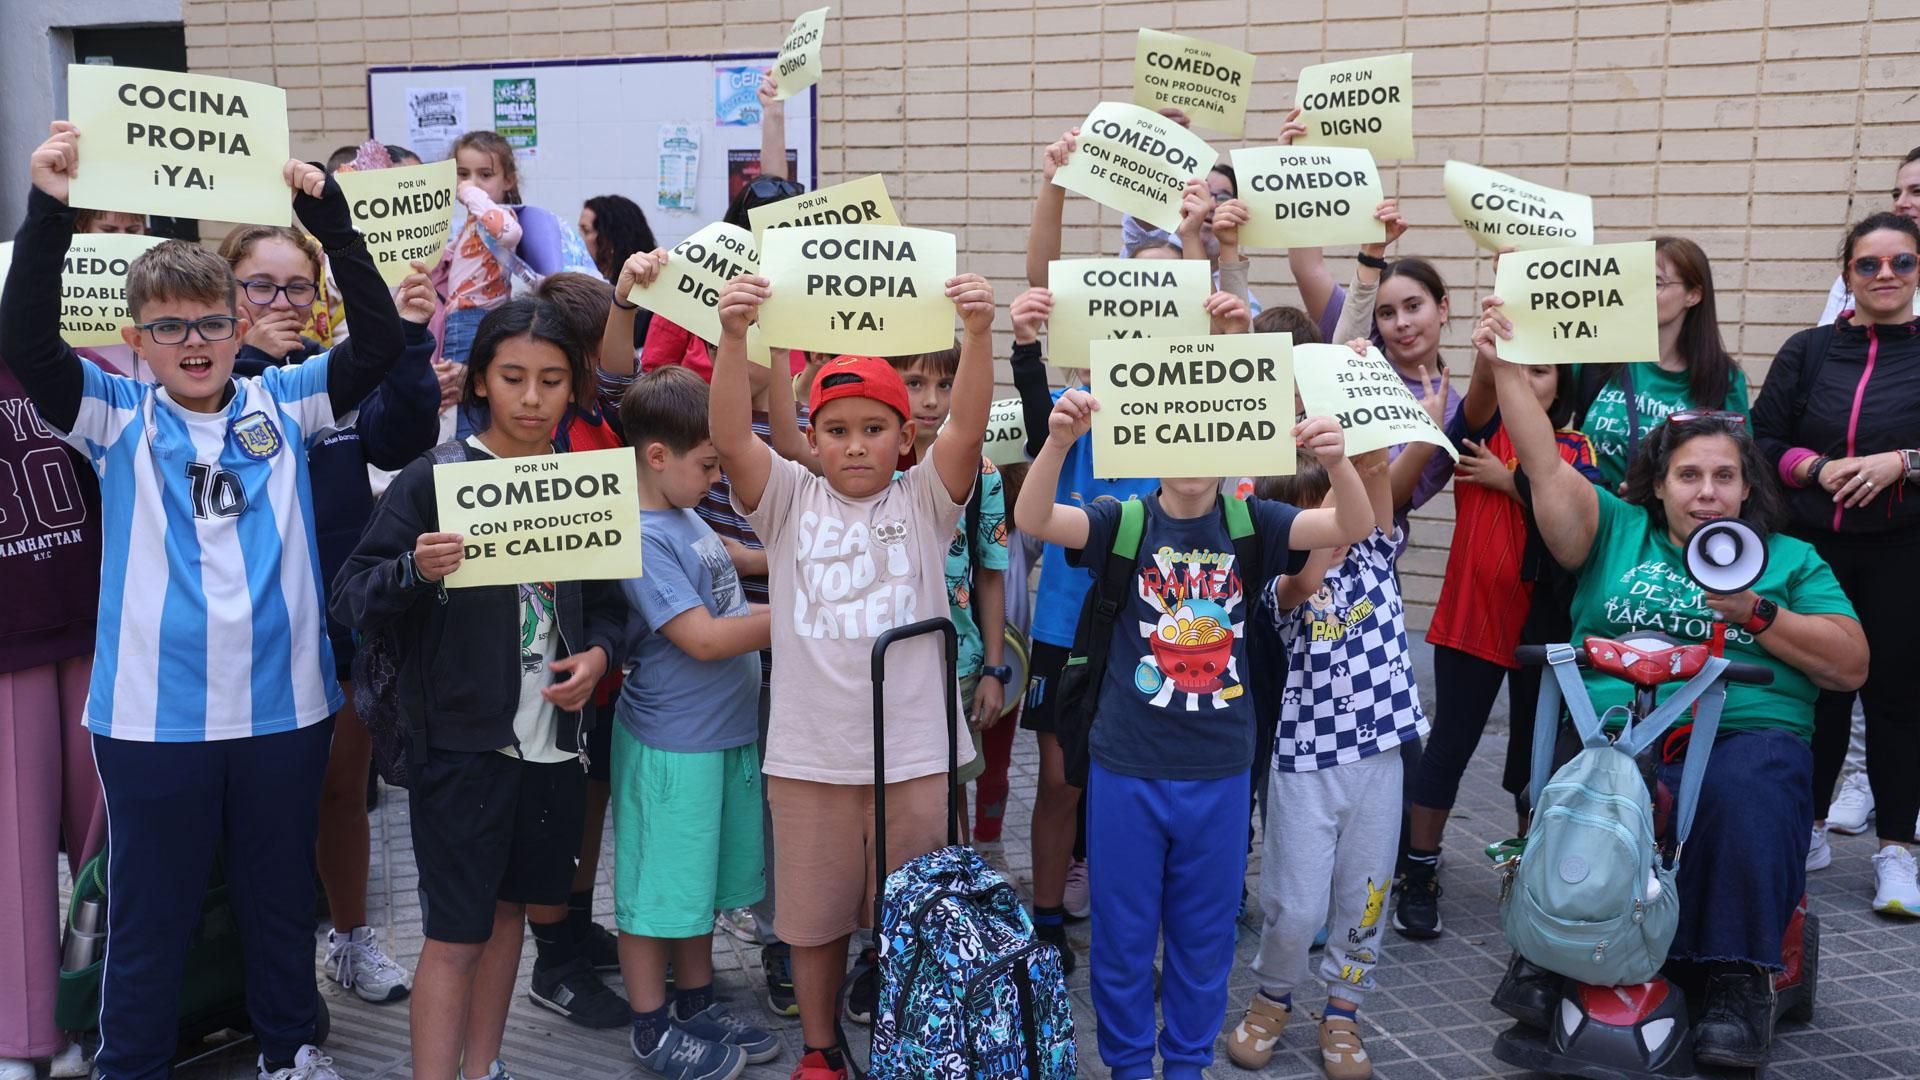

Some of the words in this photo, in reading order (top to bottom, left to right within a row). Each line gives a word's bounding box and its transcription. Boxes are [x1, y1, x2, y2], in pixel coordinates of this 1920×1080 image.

[782, 28, 818, 53] MEDOR
[1184, 47, 1200, 56] POR
[1201, 49, 1212, 58] UN
[780, 53, 807, 76] DIGNO
[1146, 51, 1242, 86] COMEDOR
[1329, 71, 1353, 83] POR
[1355, 69, 1373, 81] UN
[1144, 74, 1169, 87] CON
[1171, 80, 1238, 103] PRODUCTOS
[1302, 86, 1400, 111] COMEDOR
[118, 83, 249, 118] COCINA
[1155, 90, 1169, 102] DE
[1171, 93, 1225, 114] CERCANÍA
[1137, 119, 1152, 132] POR
[1154, 125, 1167, 136] UN
[1320, 116, 1382, 136] DIGNO
[126, 122, 251, 156] PROPIA
[1090, 118, 1199, 174] COMEDOR
[1082, 142, 1110, 165] CON
[1112, 152, 1185, 191] PRODUCTOS
[1279, 156, 1309, 168] POR
[1311, 155, 1331, 166] UN
[154, 165, 215, 190] ¡YA!
[398, 181, 414, 189] POR
[415, 179, 426, 188] UN
[1090, 164, 1108, 180] DE
[1109, 173, 1169, 204] CERCANÍA
[1250, 170, 1368, 193] COMEDOR
[353, 188, 451, 220] COMEDOR
[798, 199, 815, 211] POR
[816, 195, 828, 207] UN
[1490, 182, 1514, 195] POR
[1517, 189, 1547, 204] UNA
[1275, 199, 1351, 220] DIGNO
[1470, 193, 1565, 222] COCINA
[397, 219, 449, 241] PRODUCTOS
[1464, 220, 1481, 231] EN
[1483, 222, 1502, 234] MI
[1505, 222, 1578, 239] COLEGIO
[379, 251, 397, 263] DE
[402, 241, 441, 260] CERCANÍA
[716, 234, 745, 256] POR
[747, 249, 761, 266] U
[801, 239, 916, 262] COCINA
[1083, 270, 1178, 288] COCINA
[1526, 257, 1621, 280] COCINA
[807, 274, 917, 298] PROPIA
[1088, 300, 1179, 318] PROPIA
[1531, 289, 1624, 310] PROPIA
[98, 306, 108, 317] Y
[831, 311, 884, 331] ¡YA!
[60, 322, 116, 332] ALIDAD
[1552, 321, 1598, 340] ¡YA!
[1169, 344, 1194, 354] POR
[1196, 343, 1215, 353] UN
[1109, 358, 1277, 388] COMEDOR
[1347, 359, 1391, 370] ALIDAD
[1336, 373, 1354, 383] DE
[1360, 372, 1367, 381] Y
[1120, 402, 1159, 416] CON
[1164, 398, 1267, 413] PRODUCTOS
[1335, 405, 1438, 429] OMEDOR
[1113, 425, 1146, 445] DE
[1155, 418, 1276, 444] CALIDAD
[1595, 416, 1622, 433] DE
[324, 436, 338, 446] blue
[514, 463, 536, 474] POR
[540, 462, 559, 473] UN
[185, 461, 249, 520] 10
[456, 473, 621, 509] COMEDOR
[470, 520, 508, 537] CON
[512, 510, 613, 531] PRODUCTOS
[798, 509, 870, 560] SEA
[464, 538, 497, 560] DE
[504, 529, 623, 556] CALIDAD
[802, 549, 876, 605] YOU
[1143, 567, 1243, 599] RAMEN
[1630, 580, 1665, 602] DE
[793, 584, 918, 641] LATER
[1607, 602, 1664, 629] PARA
